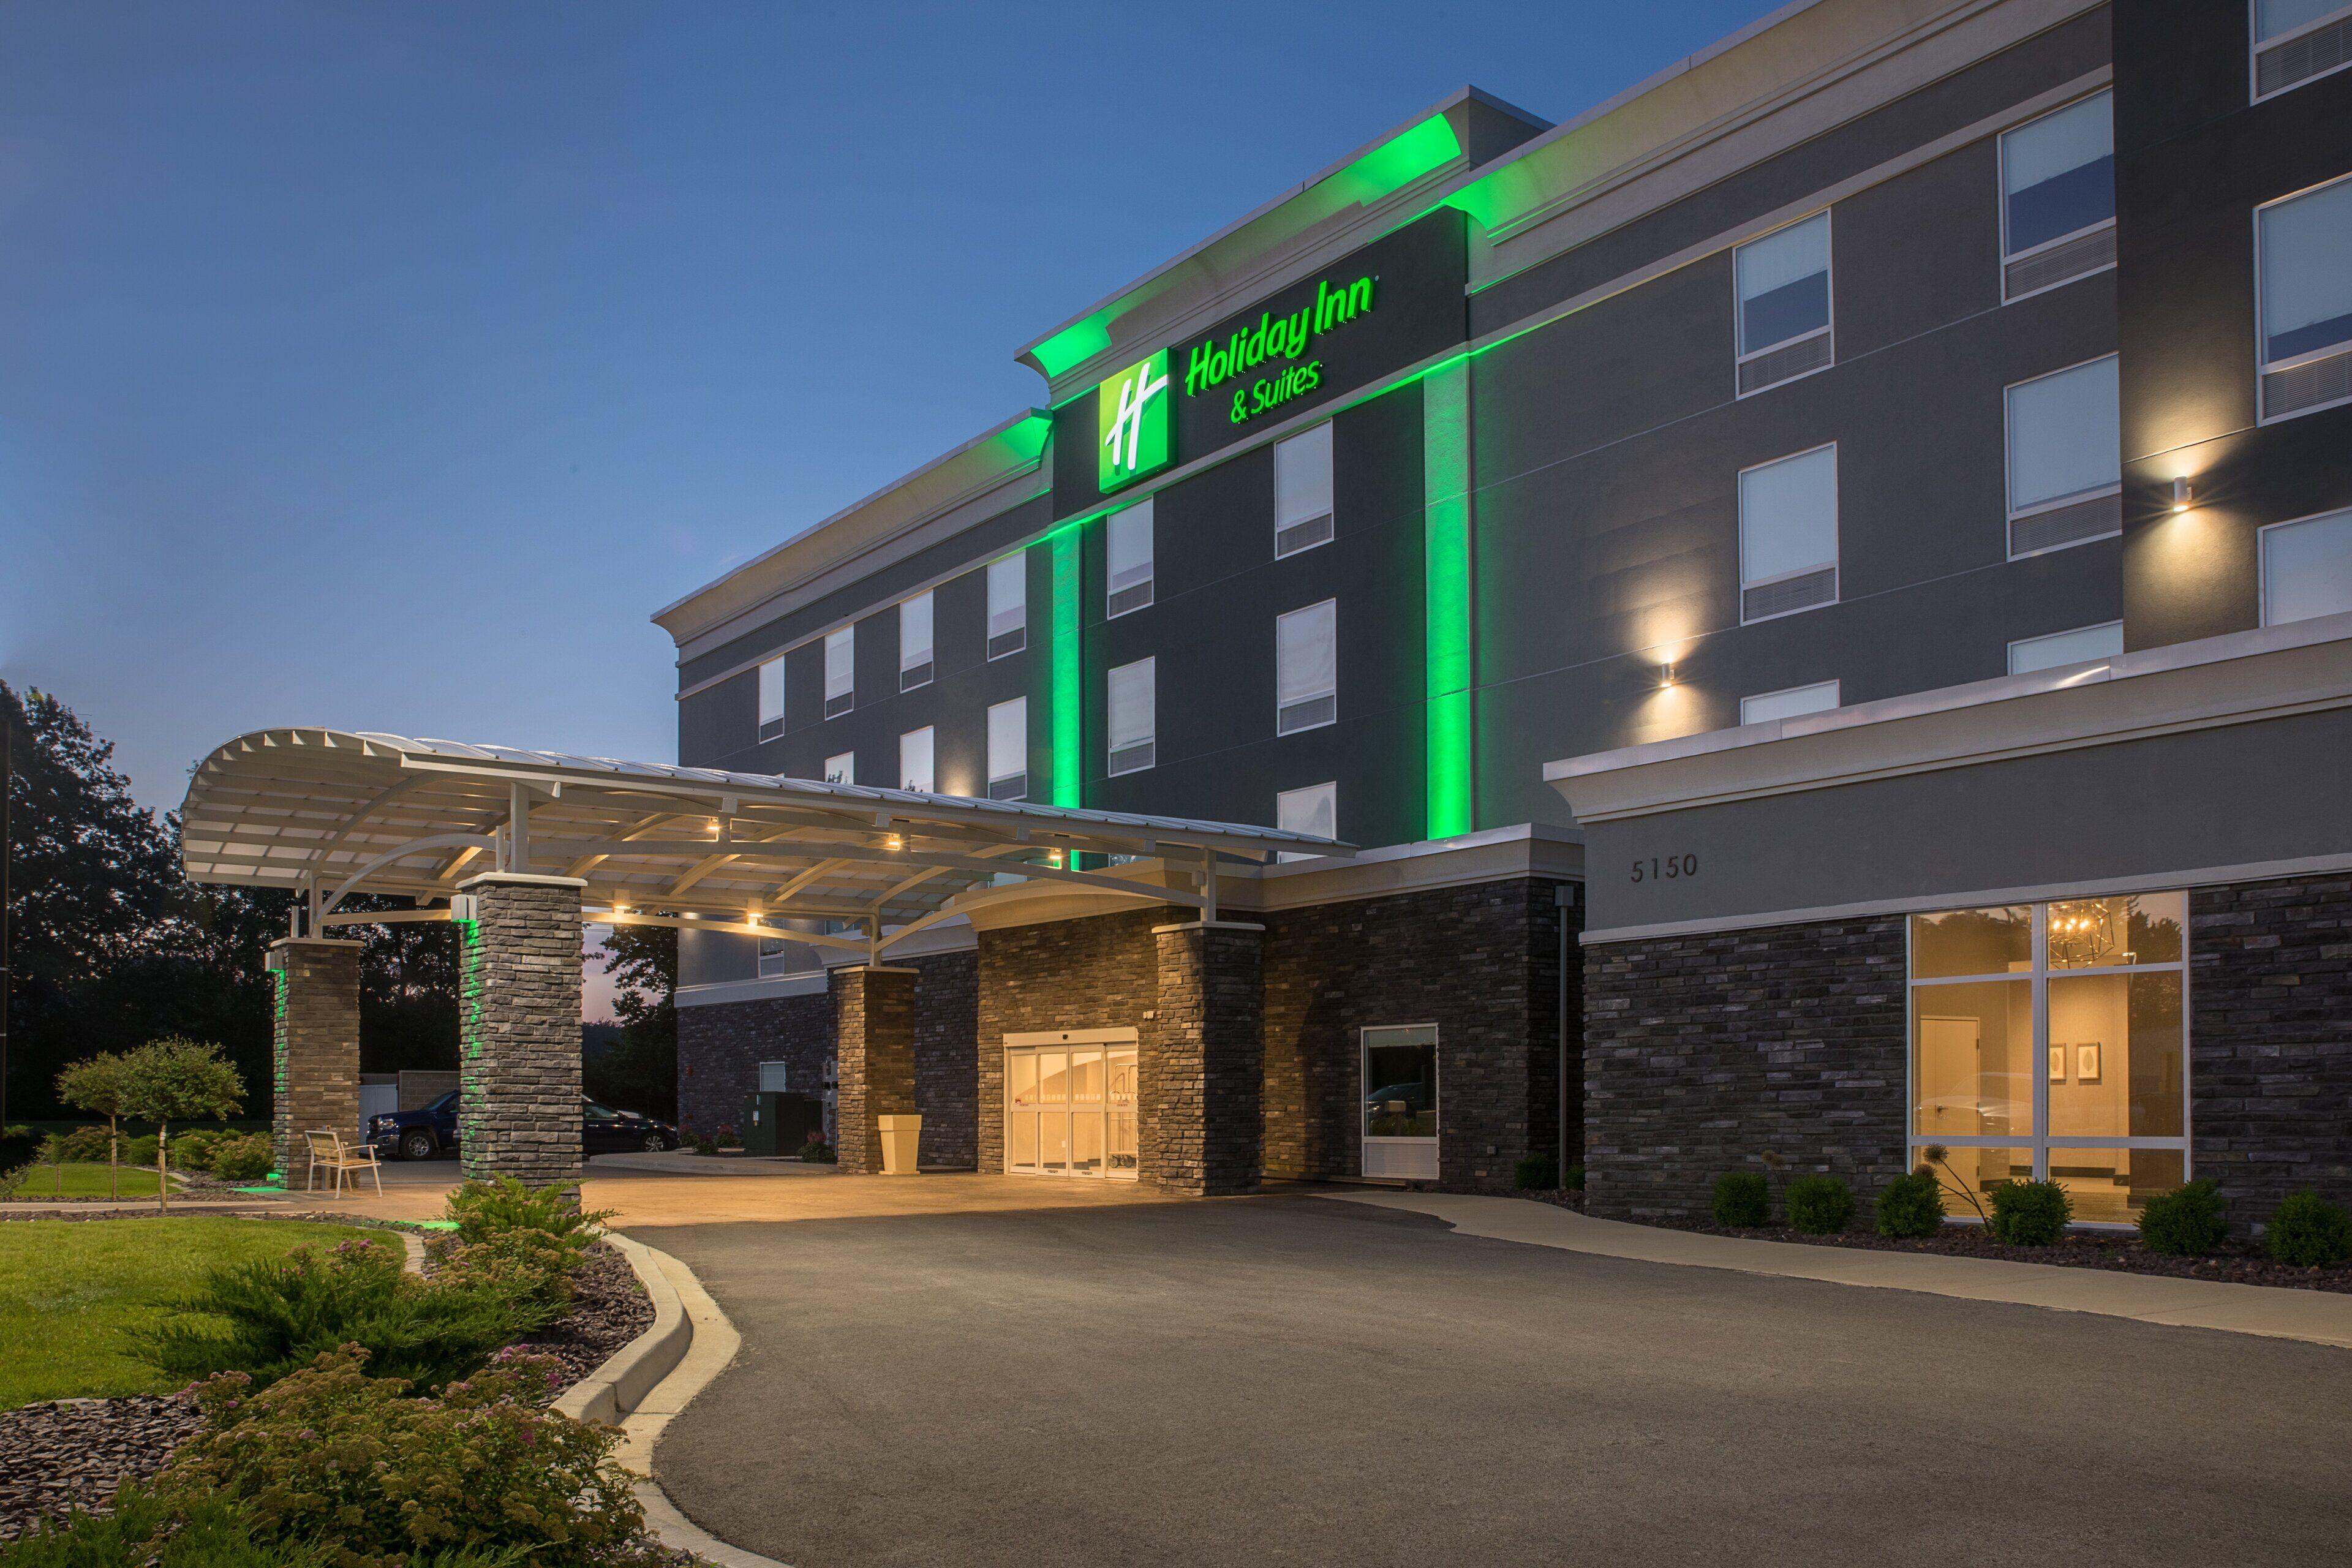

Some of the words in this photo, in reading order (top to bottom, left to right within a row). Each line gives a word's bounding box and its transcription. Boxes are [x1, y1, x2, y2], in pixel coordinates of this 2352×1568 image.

[1185, 306, 1311, 397] Holiday
[1314, 277, 1372, 334] Inn
[1105, 362, 1168, 470] H
[1230, 389, 1248, 424] &
[1250, 360, 1321, 415] Suites
[1630, 853, 1697, 883] 5150
